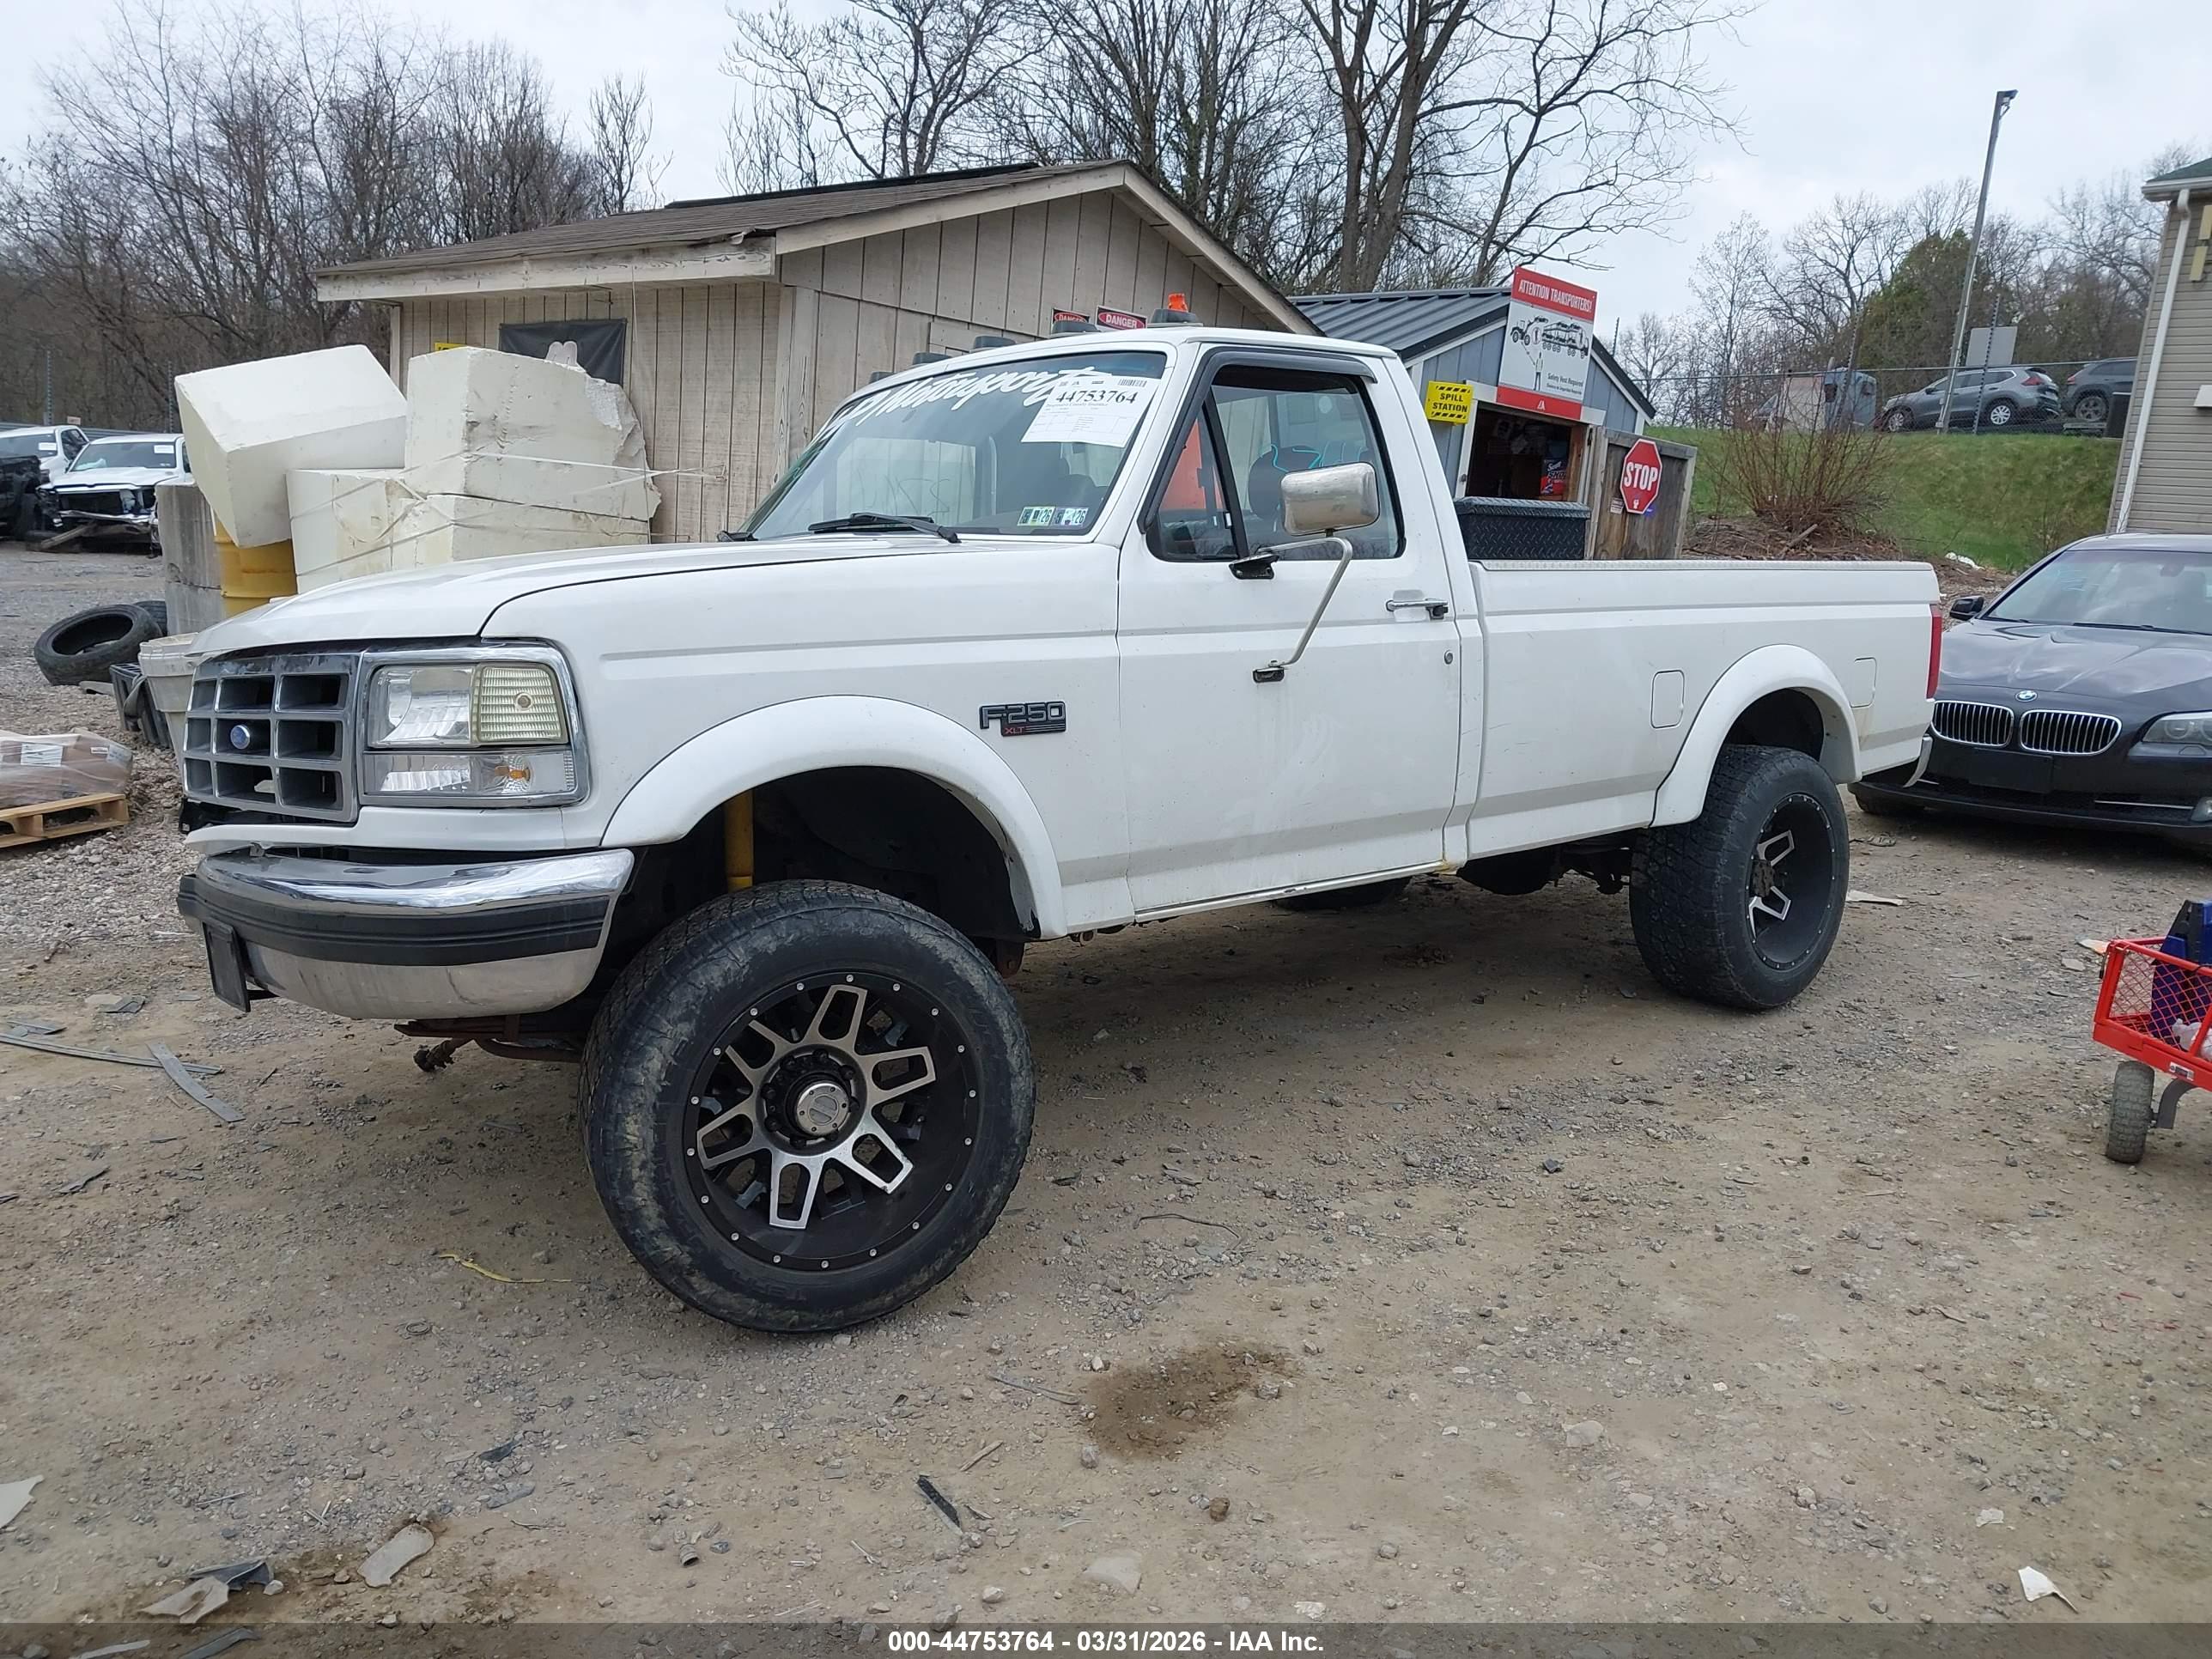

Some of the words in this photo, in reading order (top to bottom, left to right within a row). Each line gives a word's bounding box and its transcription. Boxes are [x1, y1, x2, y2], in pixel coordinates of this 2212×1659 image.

[1518, 279, 1550, 301] ATTENTION
[1550, 288, 1593, 313] TRANSPORTERS!
[1105, 313, 1138, 329] DANGER
[1055, 390, 1139, 404] 44753764
[1439, 392, 1463, 402] SPILL
[1432, 402, 1468, 413] STATION
[1623, 461, 1659, 491] STOP
[1004, 726, 1026, 735] XLT
